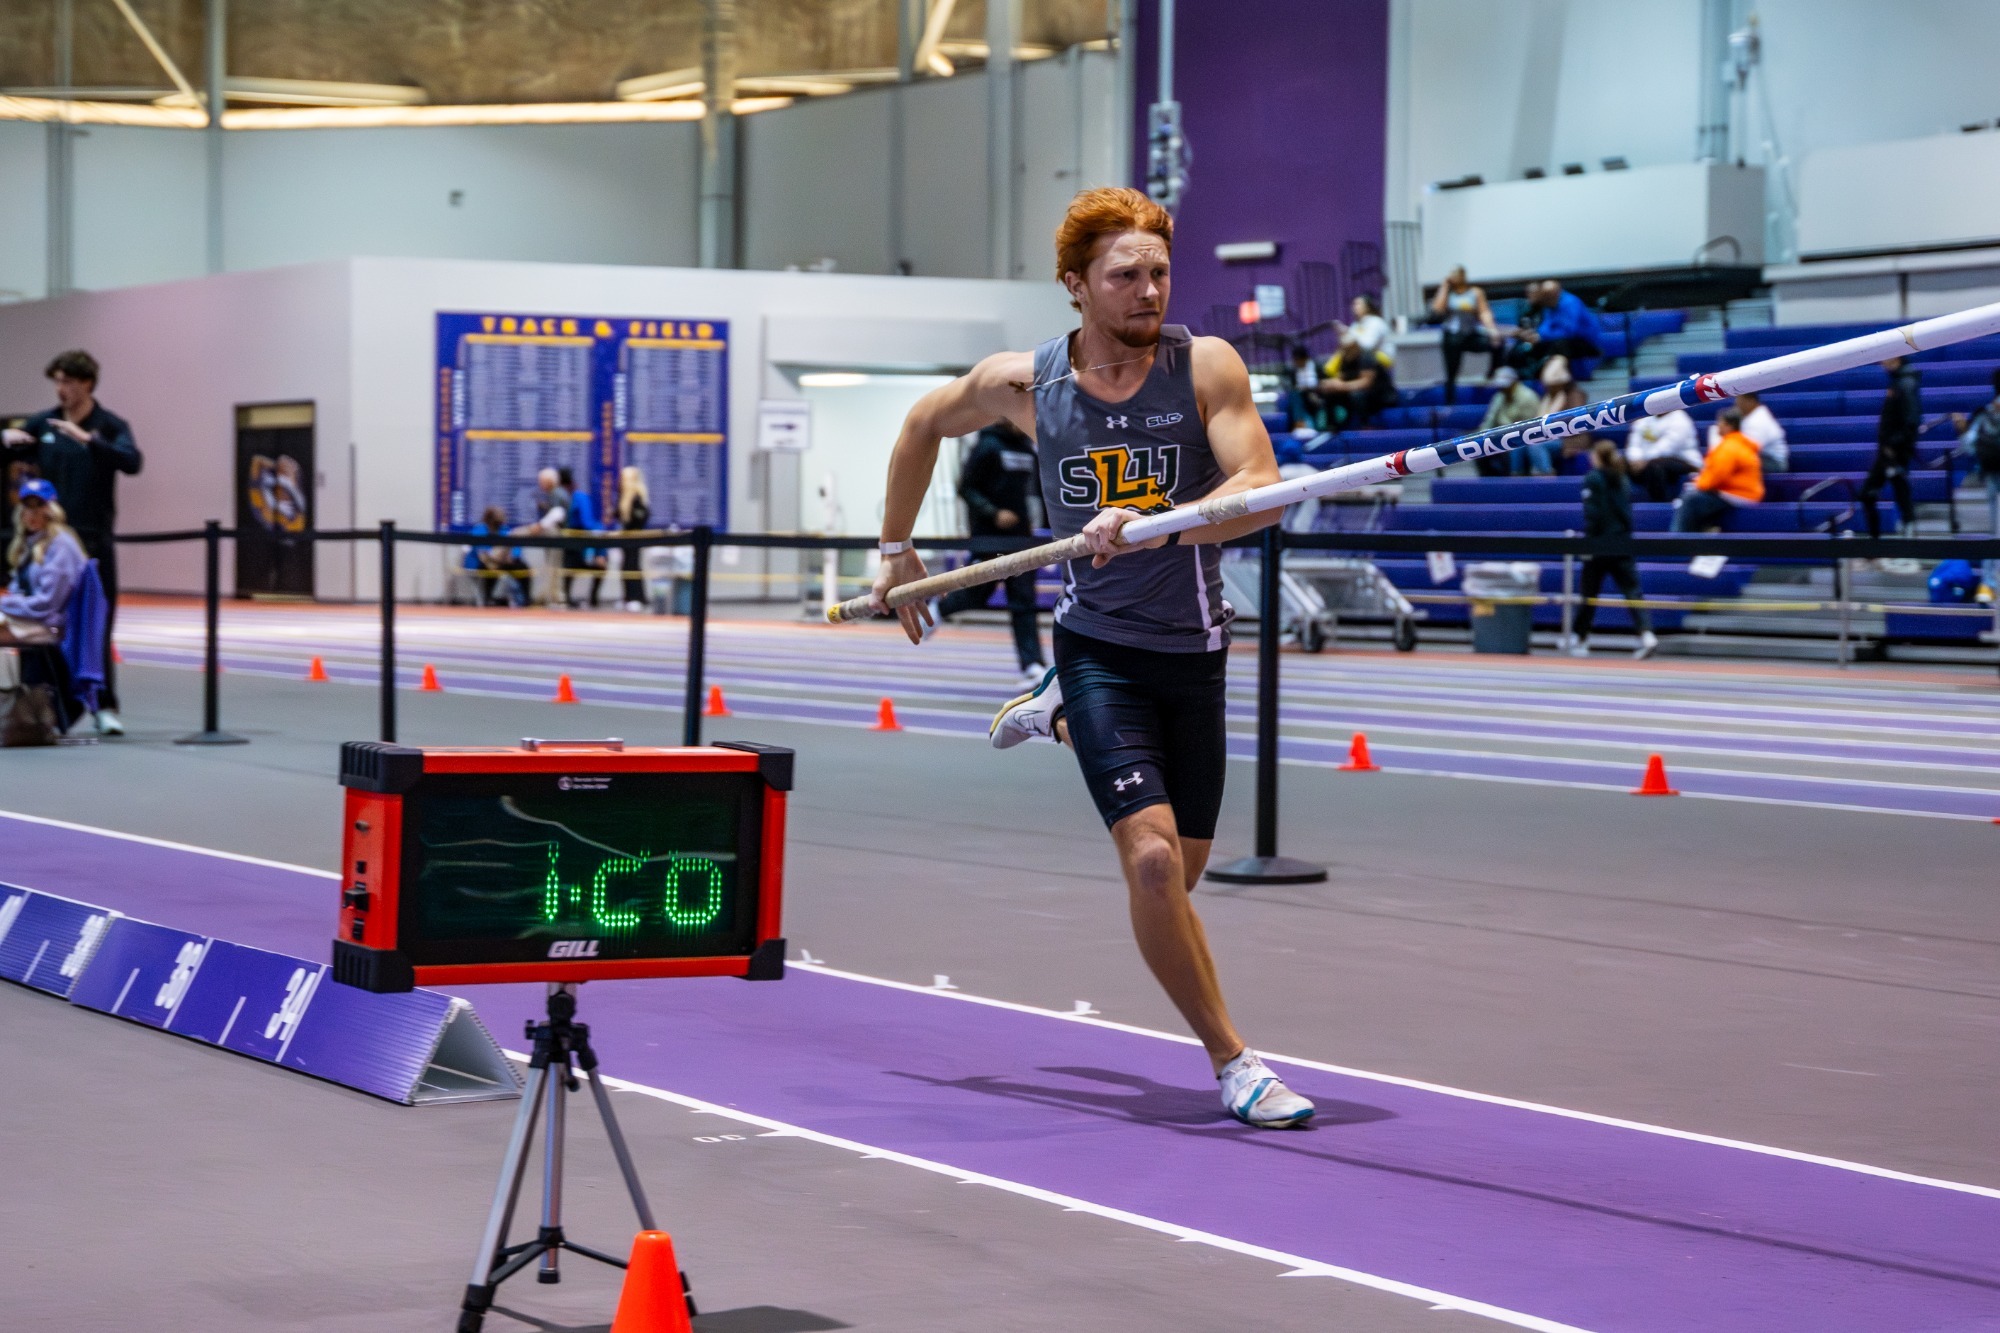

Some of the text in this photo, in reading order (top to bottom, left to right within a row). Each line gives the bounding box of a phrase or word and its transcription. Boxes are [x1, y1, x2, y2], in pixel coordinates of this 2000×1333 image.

[1146, 412, 1184, 428] SLC
[1059, 443, 1181, 511] SLU
[547, 940, 600, 958] GILL
[264, 967, 318, 1041] 34
